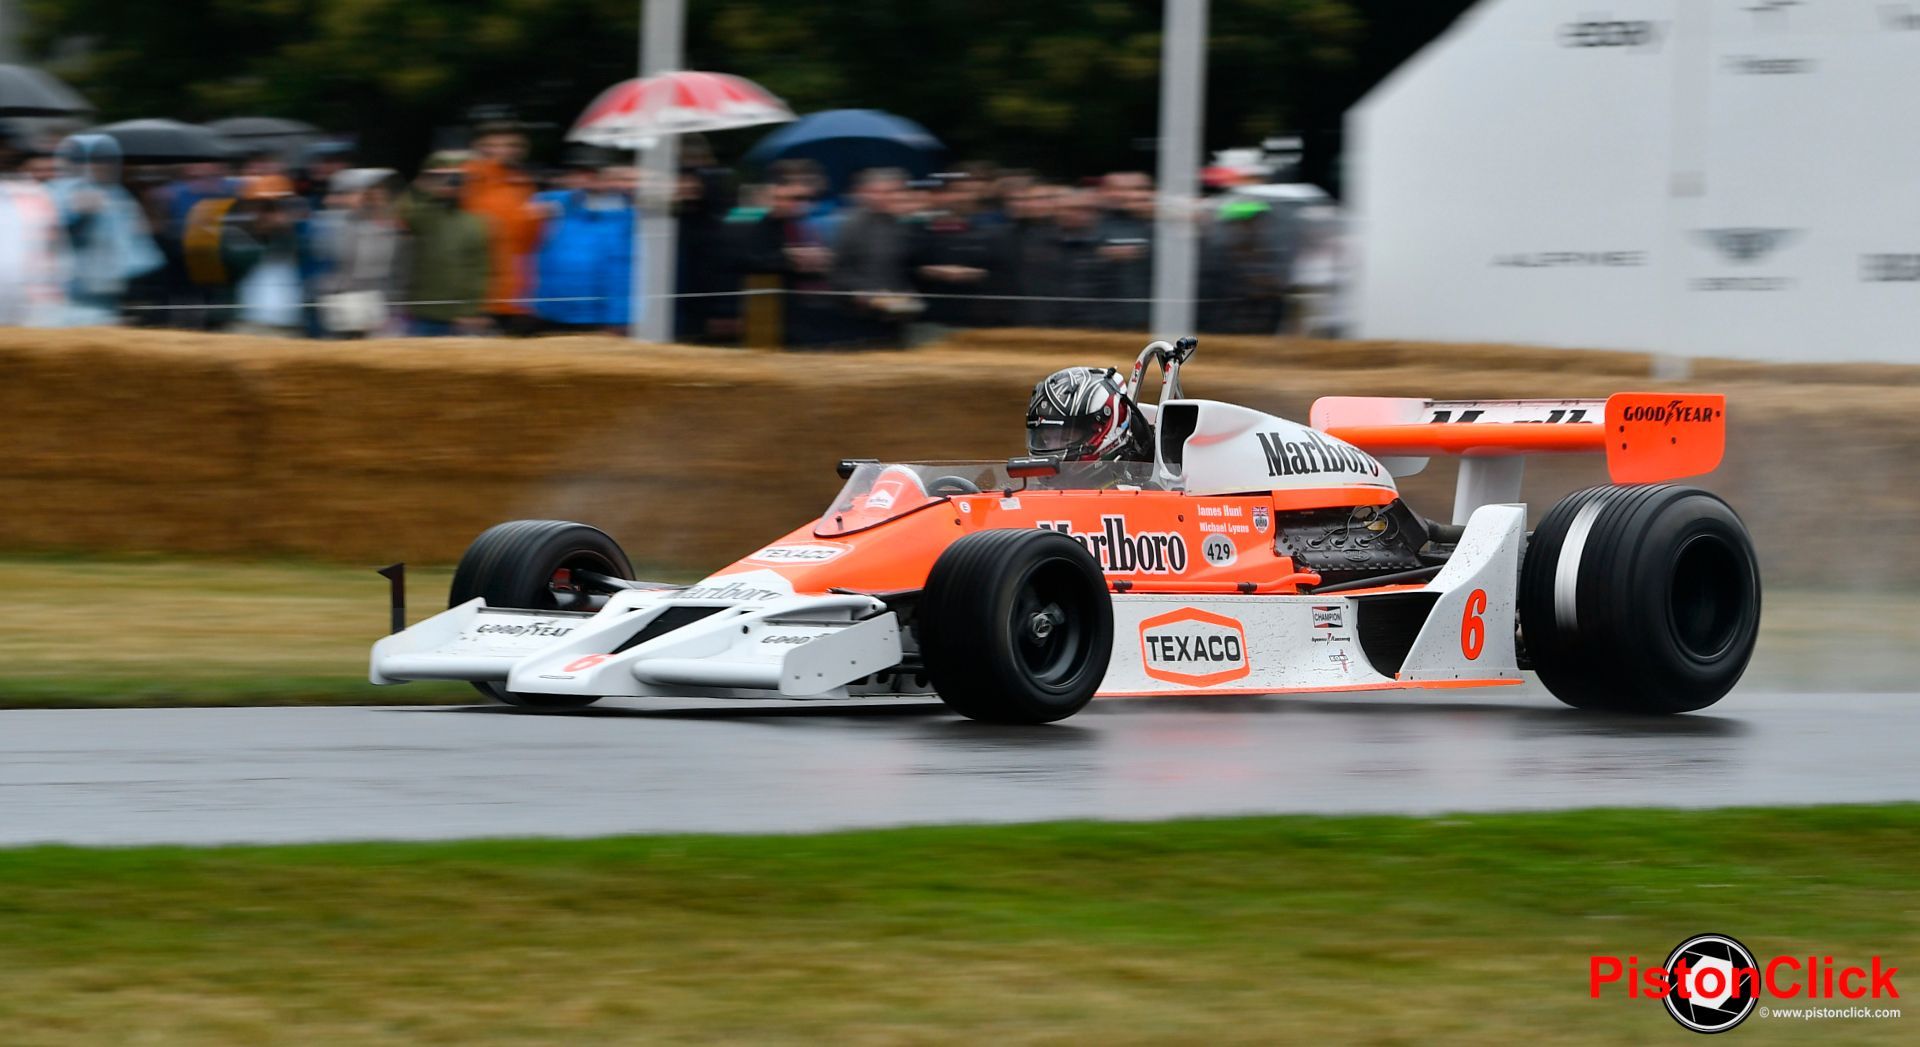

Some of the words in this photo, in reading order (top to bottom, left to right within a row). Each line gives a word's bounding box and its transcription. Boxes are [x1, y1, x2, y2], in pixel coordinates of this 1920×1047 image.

[1256, 429, 1379, 477] Marlboro
[1198, 504, 1222, 516] James
[1223, 504, 1243, 516] Hunt
[1200, 522, 1227, 532] Michael
[1228, 523, 1250, 535] Lyons
[1040, 518, 1186, 571] rlboro
[1207, 543, 1231, 560] 429
[1314, 613, 1341, 621] CHAMPION
[1461, 589, 1487, 661] 6
[1146, 635, 1241, 662] TEXACO
[563, 653, 617, 673] 6
